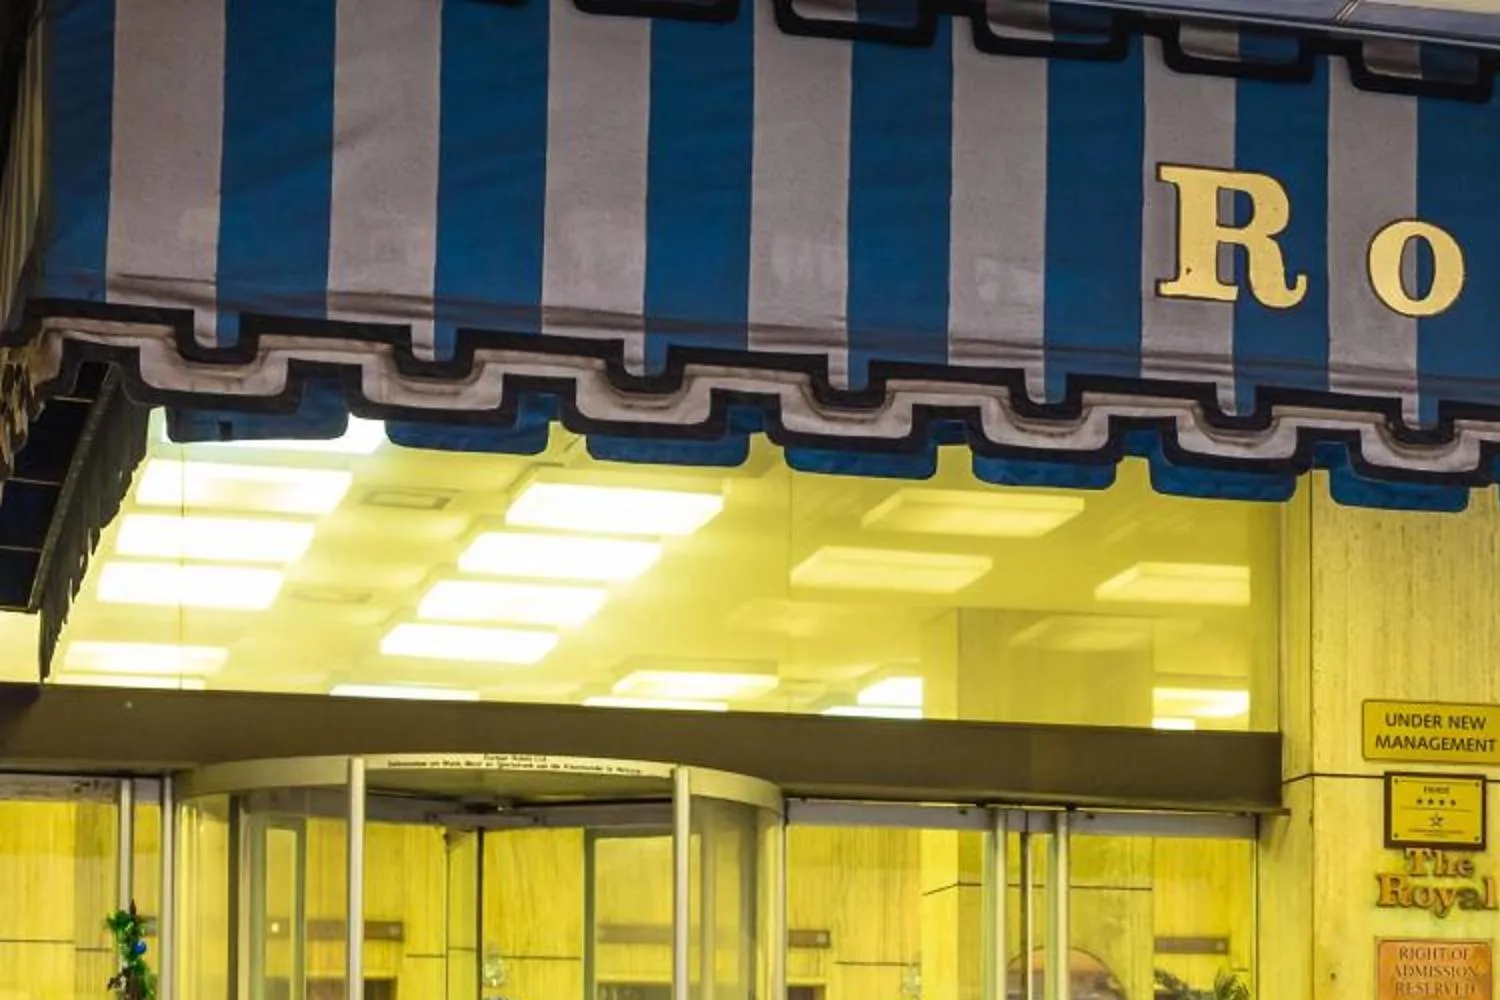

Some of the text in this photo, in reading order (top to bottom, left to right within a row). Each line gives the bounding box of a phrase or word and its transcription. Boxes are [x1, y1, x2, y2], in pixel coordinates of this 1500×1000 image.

[1385, 711, 1487, 731] UNDER NEW
[1375, 734, 1496, 753] MANAGEMENT
[1405, 847, 1475, 877] The
[1376, 872, 1498, 918] Royal
[1399, 946, 1470, 961] RIGHT OF
[1394, 964, 1479, 978] ADMISSION
[1394, 981, 1476, 996] RESERVED
